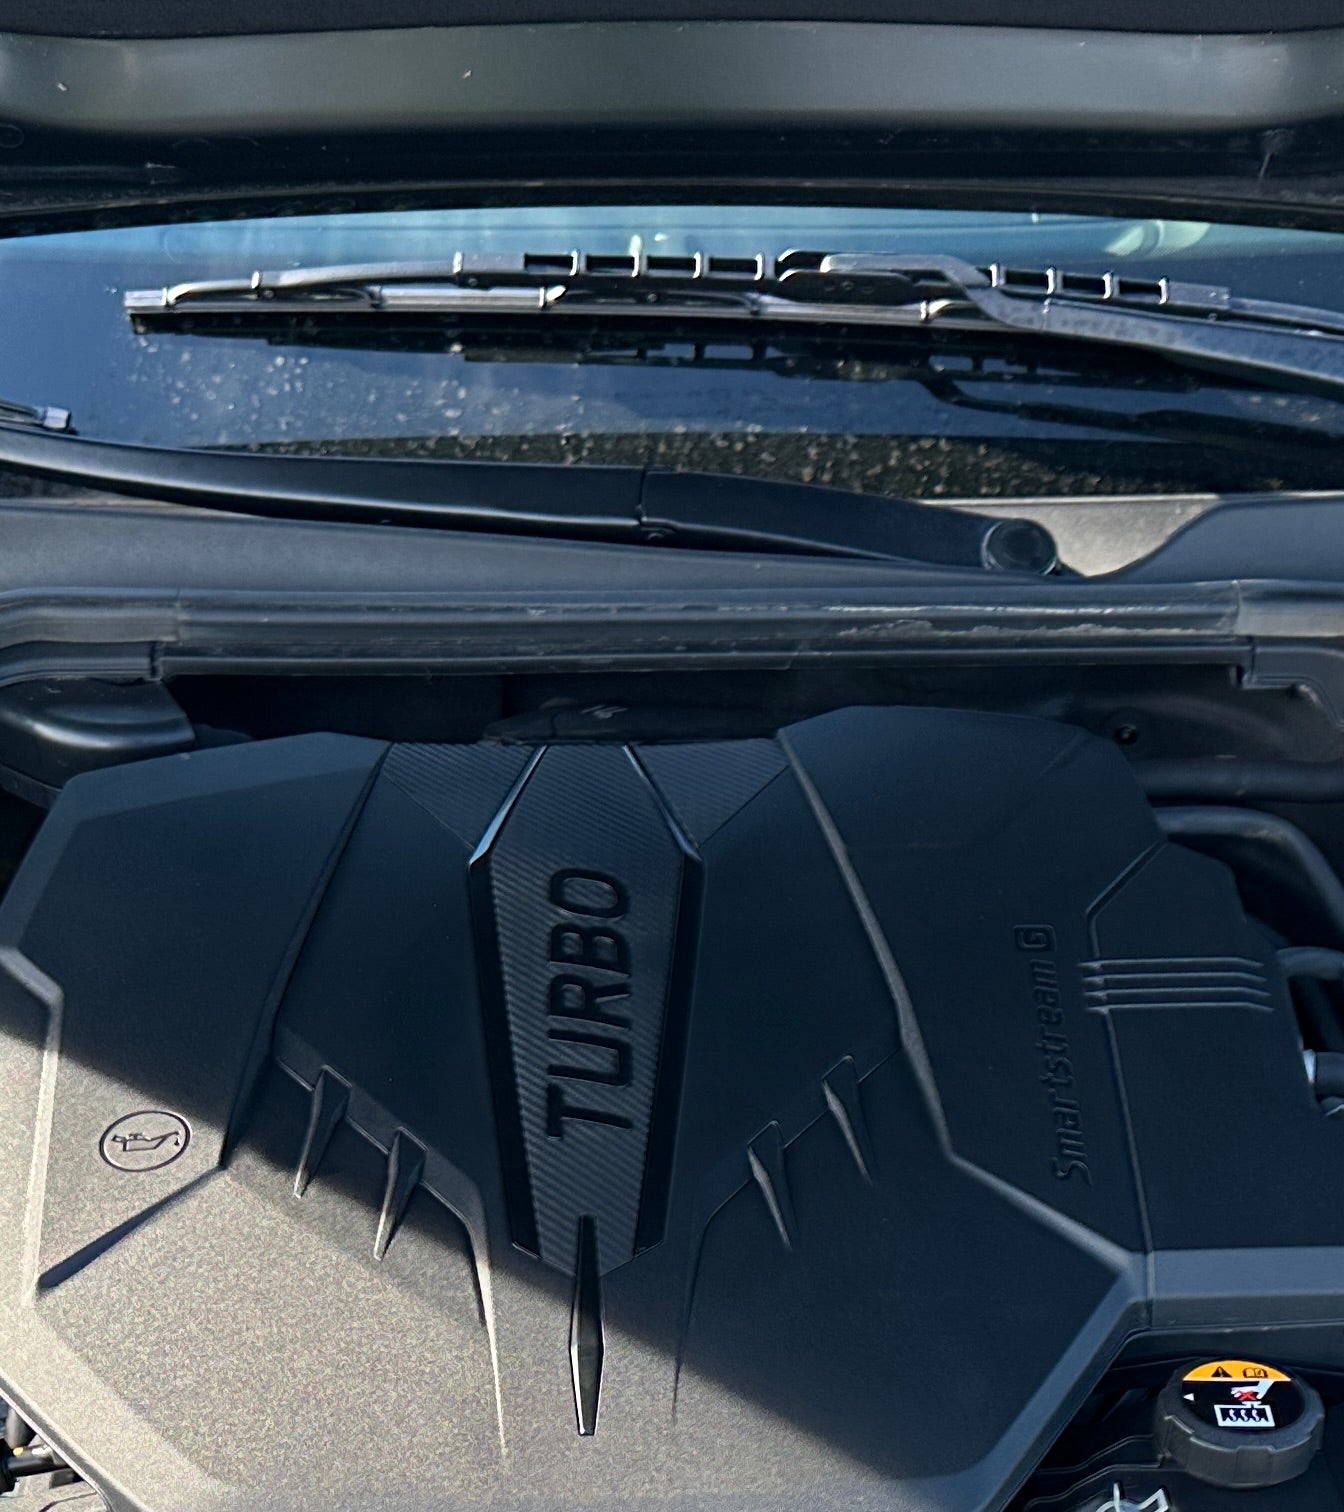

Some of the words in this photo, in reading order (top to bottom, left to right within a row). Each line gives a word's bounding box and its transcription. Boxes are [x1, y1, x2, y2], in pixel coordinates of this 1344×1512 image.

[547, 866, 634, 1141] TURBO
[1015, 925, 1055, 949] G
[1030, 958, 1093, 1186] Smartstream
